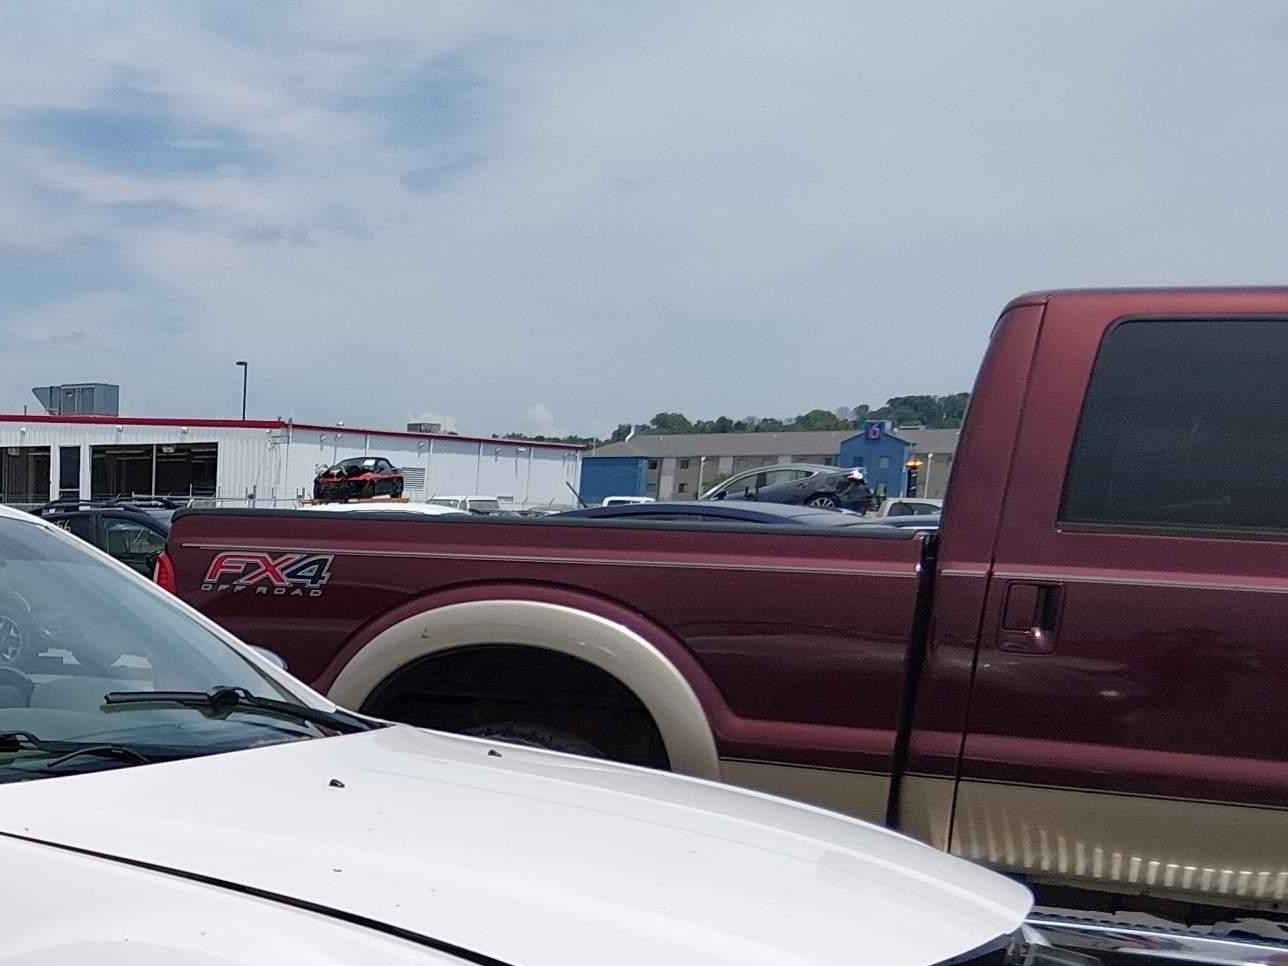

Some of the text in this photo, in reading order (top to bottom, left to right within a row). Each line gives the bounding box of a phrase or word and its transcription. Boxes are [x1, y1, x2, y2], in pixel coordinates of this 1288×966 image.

[869, 424, 880, 439] 6
[204, 551, 335, 588] FX4
[201, 583, 323, 597] OFF ROAD
